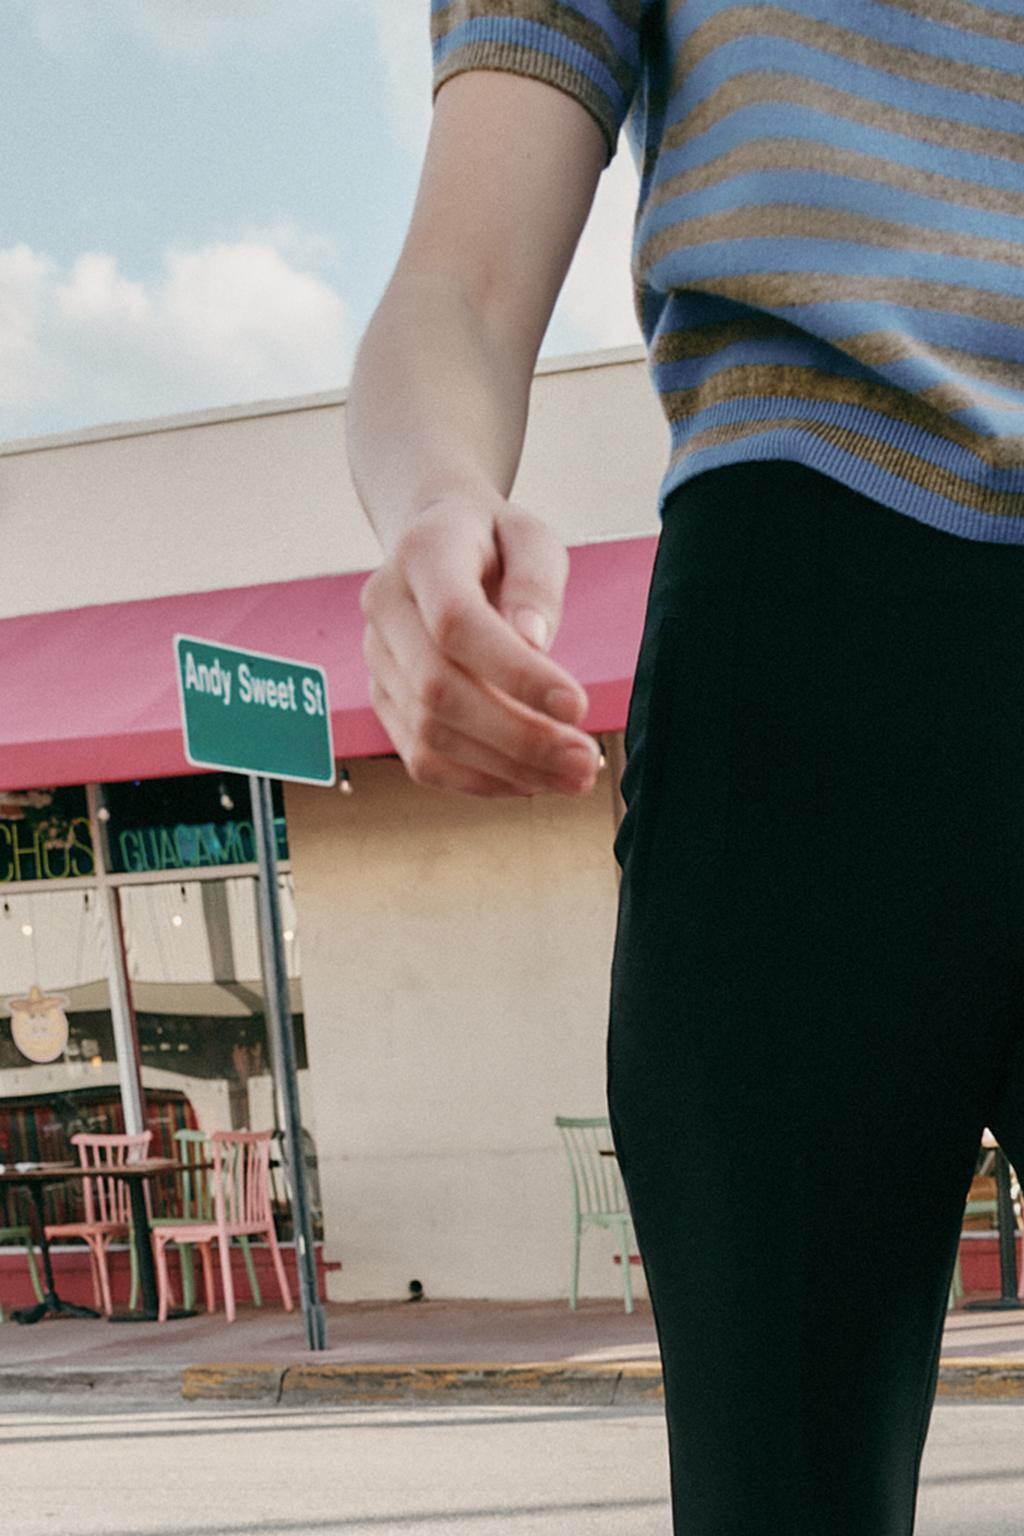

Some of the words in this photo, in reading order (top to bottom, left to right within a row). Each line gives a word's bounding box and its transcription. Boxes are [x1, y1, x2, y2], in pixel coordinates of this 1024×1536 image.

[186, 652, 231, 706] Andy
[238, 663, 298, 712] Sweet
[302, 677, 325, 717] St
